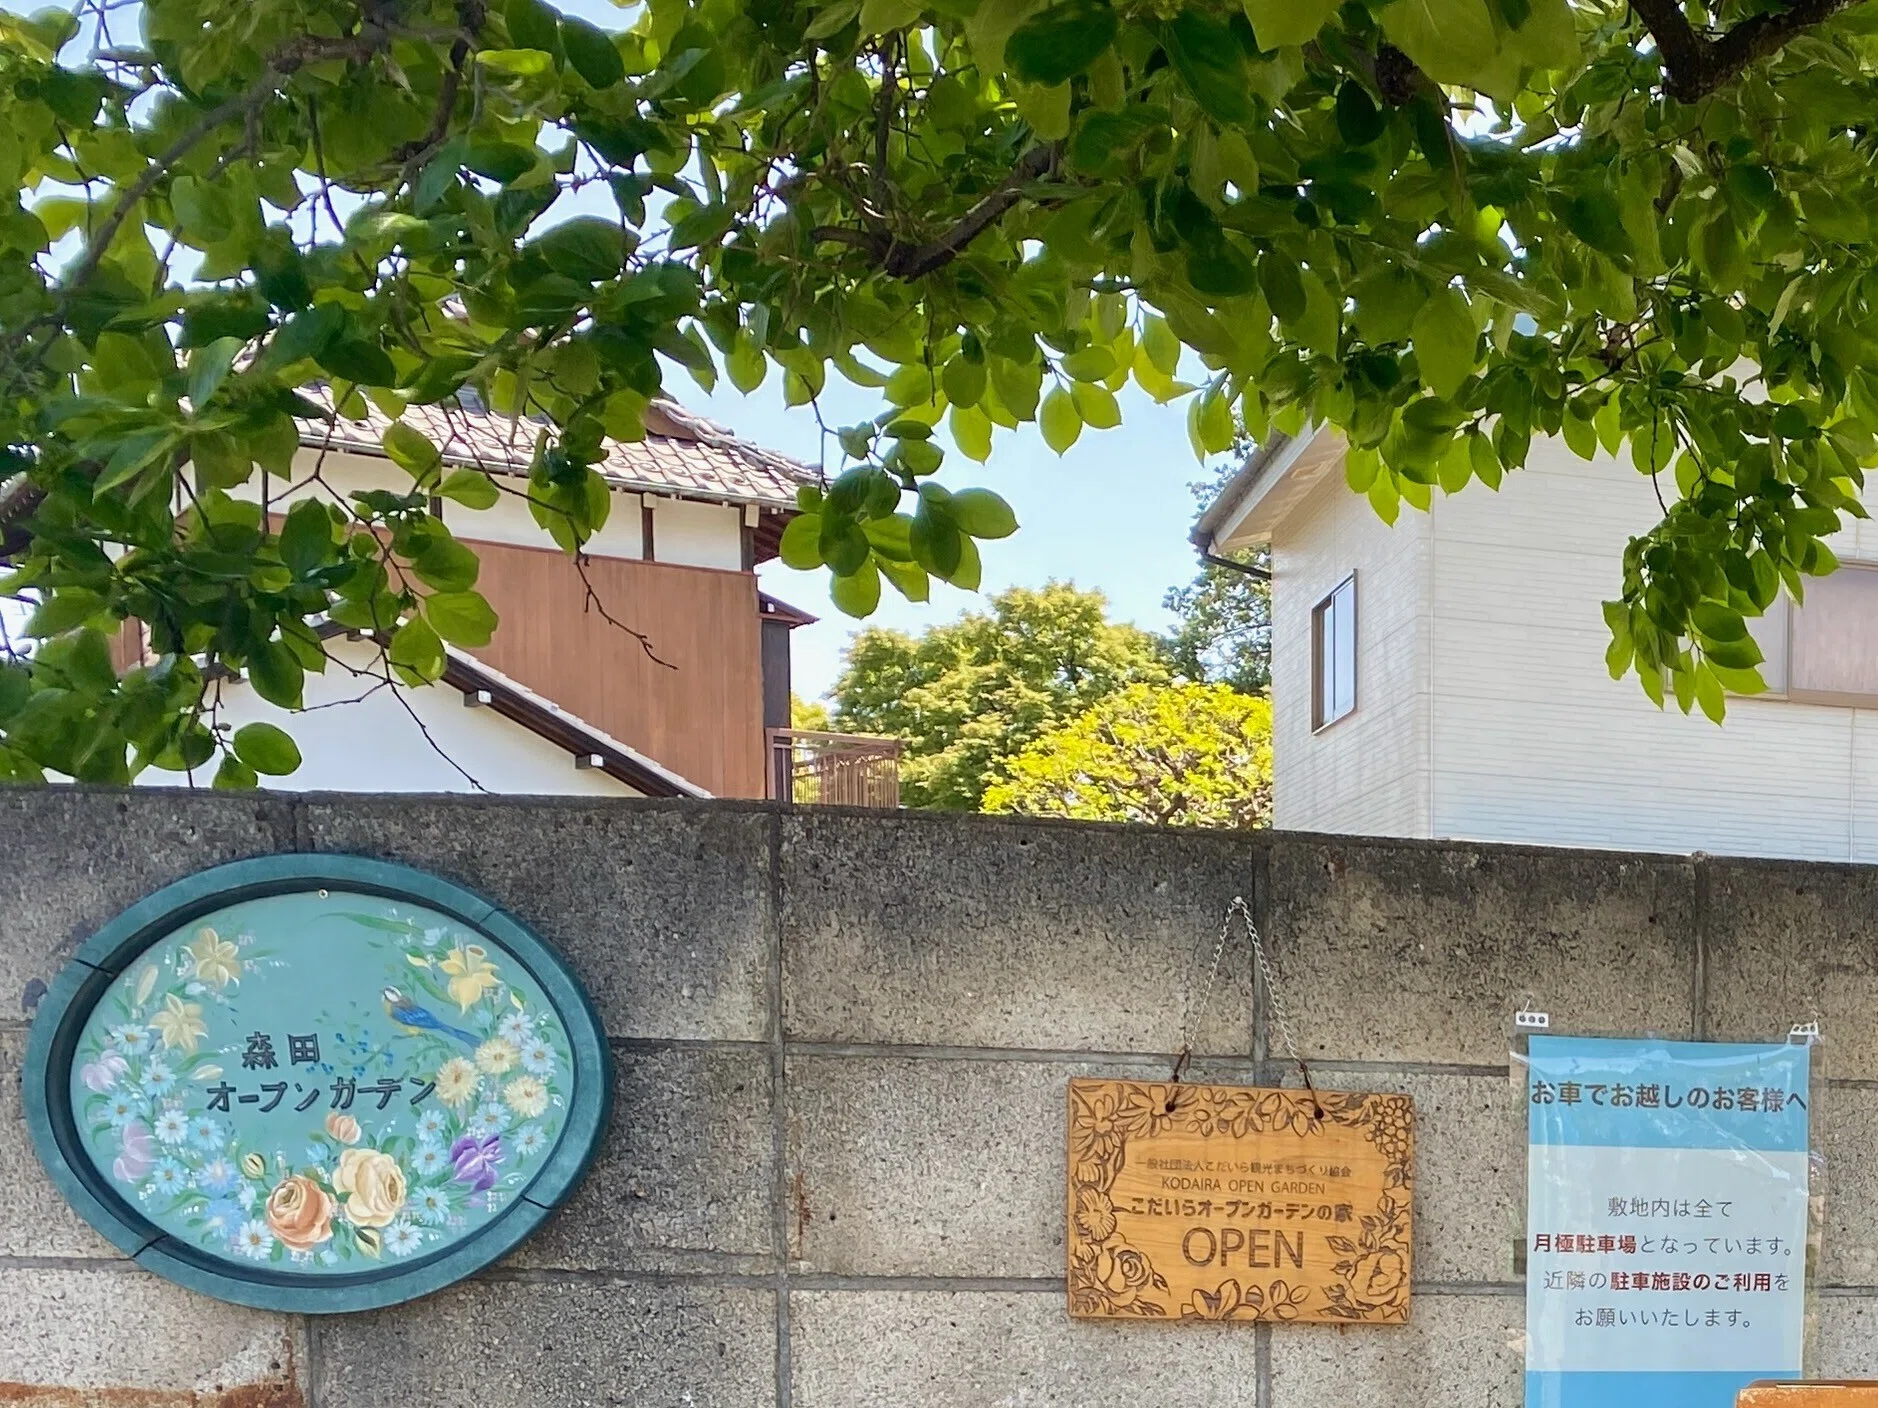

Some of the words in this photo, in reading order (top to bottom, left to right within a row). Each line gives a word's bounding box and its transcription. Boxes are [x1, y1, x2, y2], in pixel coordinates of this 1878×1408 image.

[241, 1032, 320, 1069] 森田
[206, 1077, 437, 1112] オープンガーデン
[1531, 1080, 1807, 1113] お車でお越しのお客様へ
[1161, 1177, 1222, 1192] KODAIRA
[1228, 1178, 1264, 1193] OPEN
[1271, 1181, 1326, 1195] GARDEN
[1132, 1197, 1354, 1222] こだいらオープンガーデンの家
[1607, 1197, 1733, 1218] 敷地内は全て
[1182, 1227, 1304, 1269] OPEN
[1533, 1233, 1793, 1256] 月極駐車場となっています。
[1543, 1270, 1791, 1293] 近隣の駐車施設のご利用を
[1575, 1307, 1753, 1328] お願いいたします。
